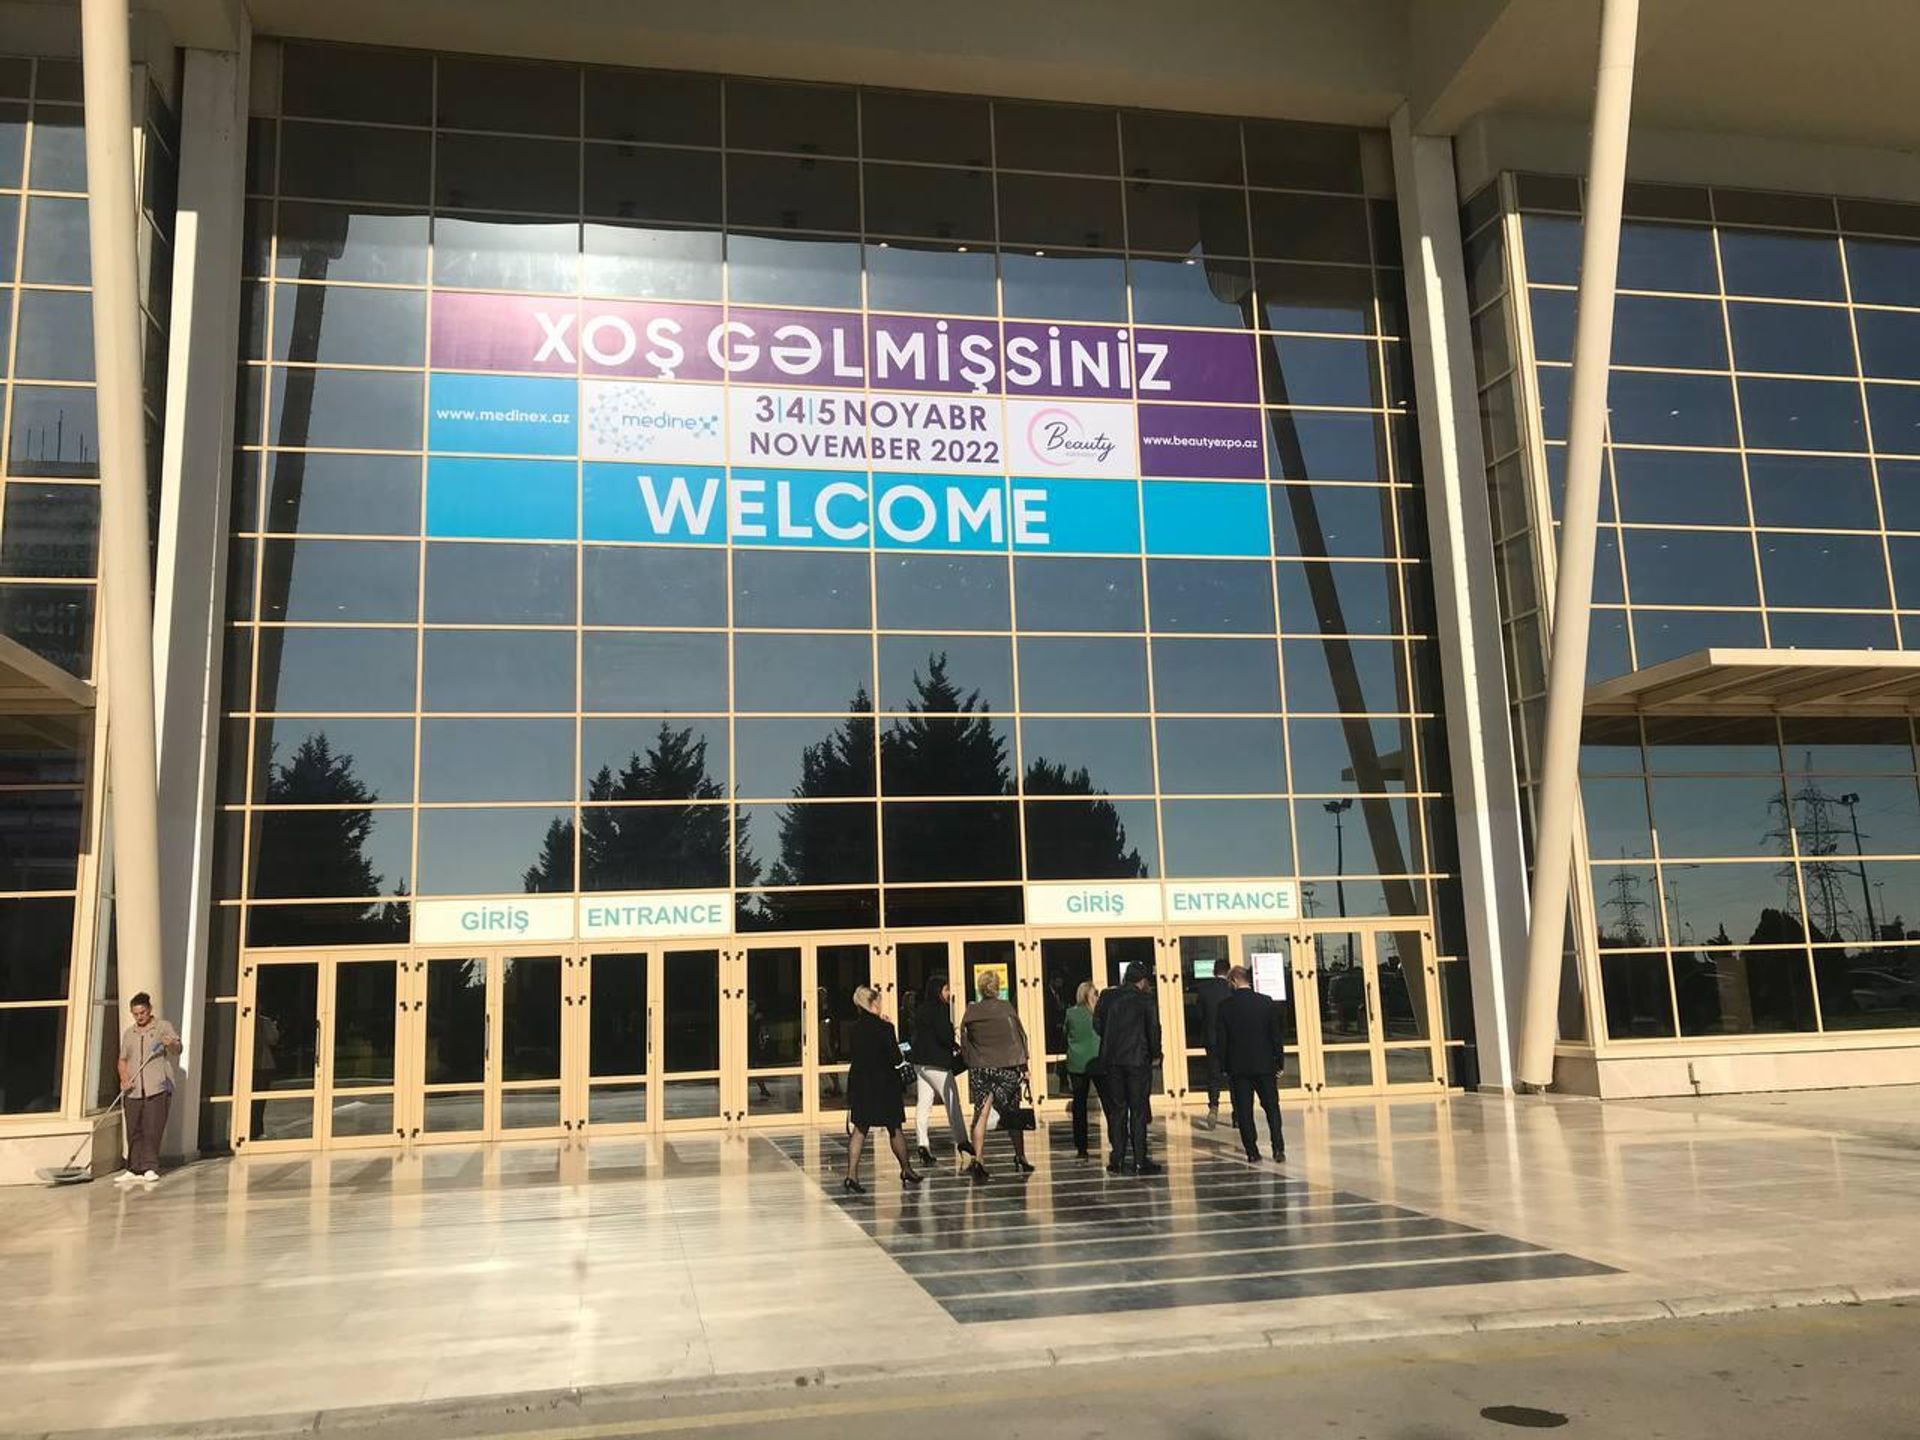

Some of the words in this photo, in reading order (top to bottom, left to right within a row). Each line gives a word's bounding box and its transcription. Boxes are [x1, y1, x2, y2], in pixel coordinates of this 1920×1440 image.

[533, 312, 684, 379] XOŞ
[707, 320, 1171, 393] GƏLMİŞSİNİZ
[437, 408, 570, 425] www.medinex.az
[845, 400, 987, 431] NOYABR
[750, 432, 921, 460] NOVEMBER
[931, 439, 999, 463] 2022
[1044, 421, 1115, 462] Beauty
[1143, 436, 1258, 449] www.beautyexpo.az
[638, 476, 1050, 544] WELCOME
[1066, 890, 1125, 916] GİRİŞ
[1174, 892, 1289, 910] ENTRANCE
[461, 906, 529, 933] GİRİŞ
[587, 904, 722, 927] ENTRANCE
